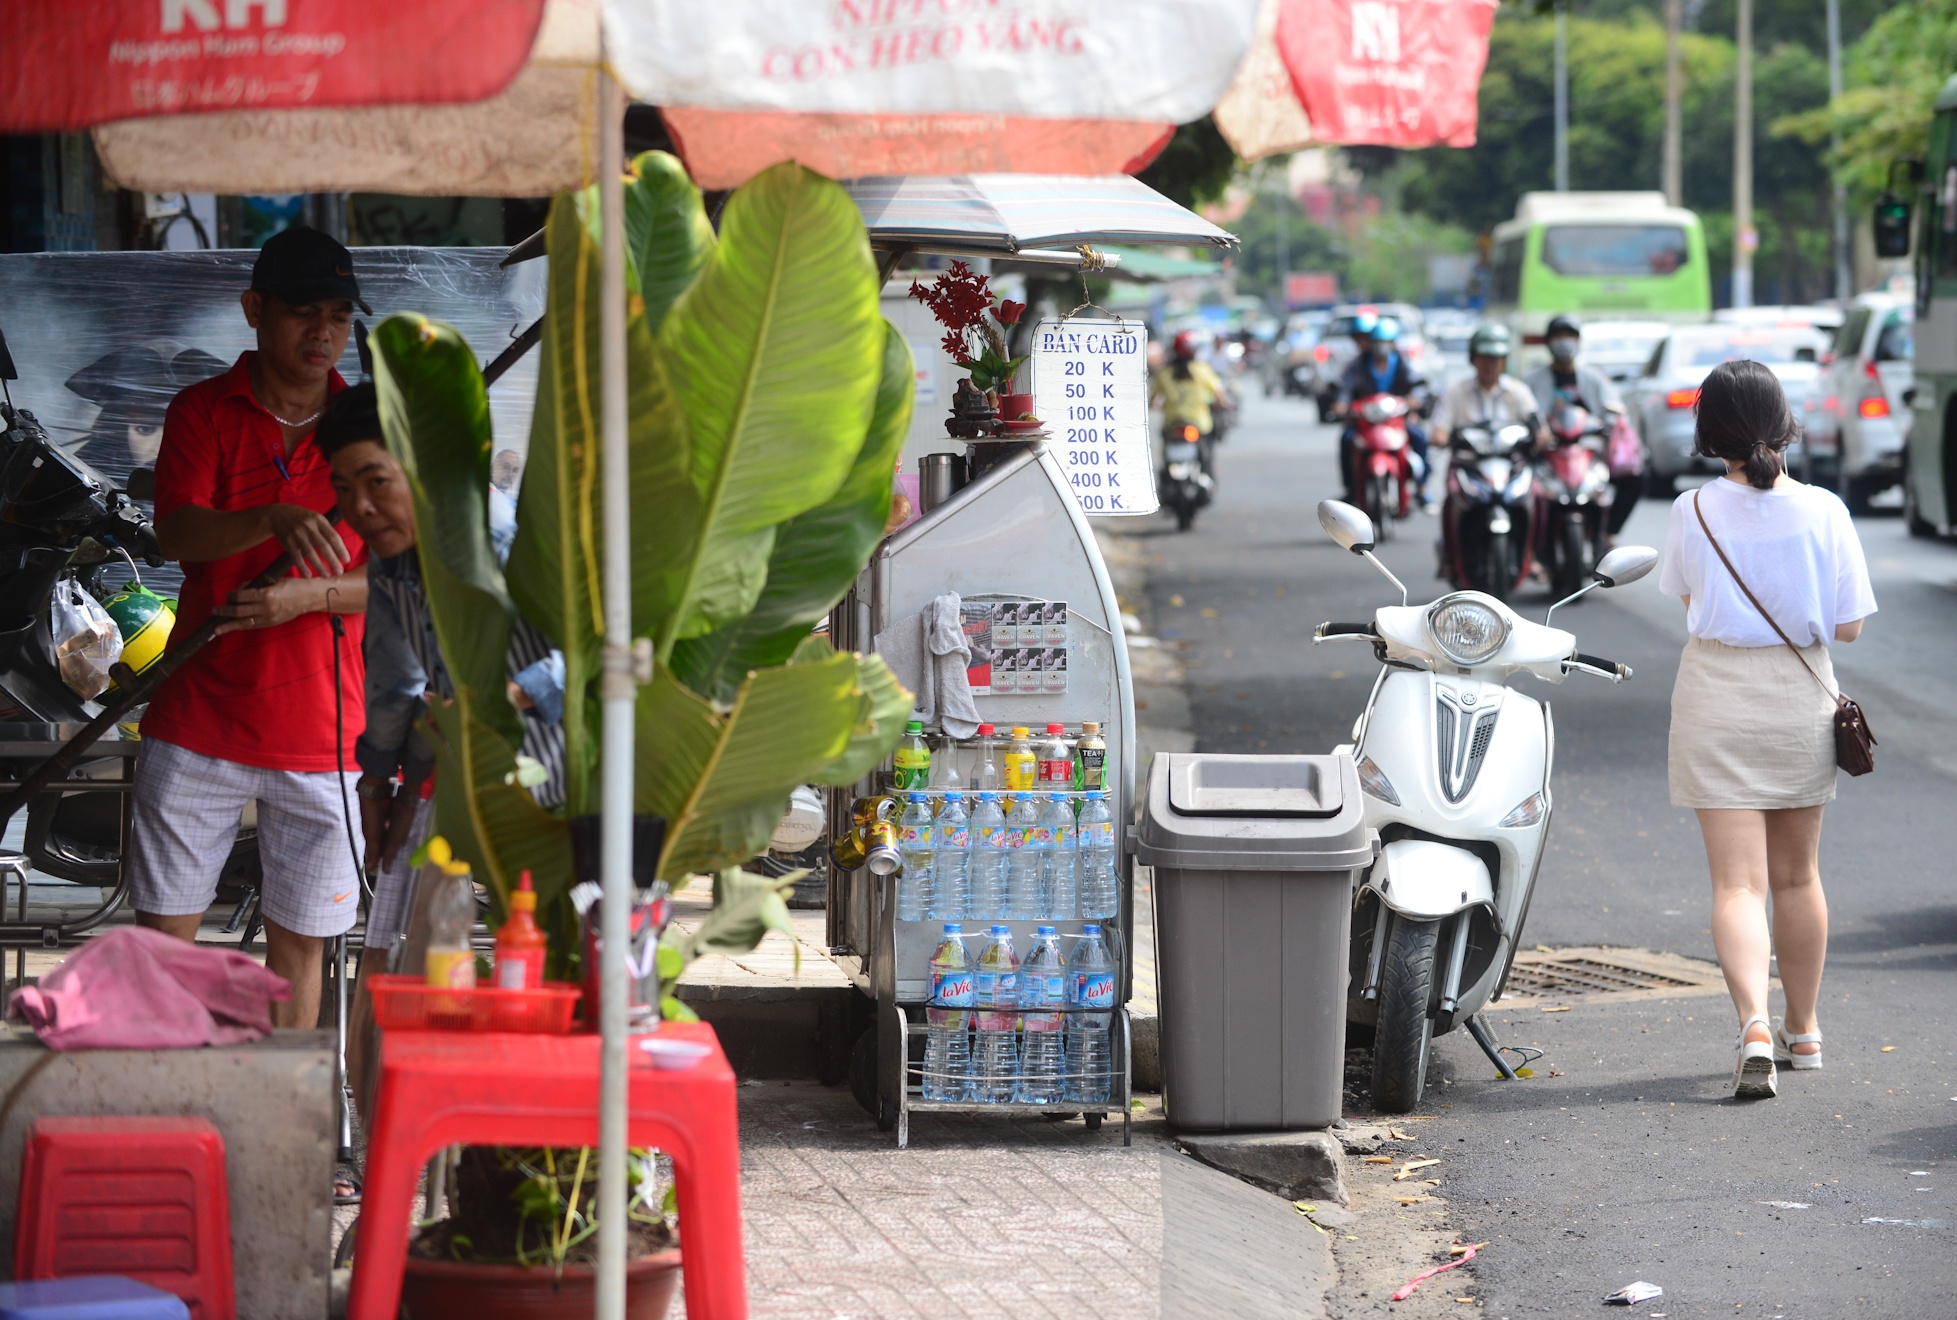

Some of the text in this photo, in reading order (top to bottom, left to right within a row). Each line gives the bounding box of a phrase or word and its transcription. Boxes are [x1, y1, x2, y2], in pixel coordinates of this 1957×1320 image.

[1042, 327, 1137, 355] BÁN CARD
[1065, 361, 1115, 376] 20 K
[1065, 383, 1115, 398] 50 K
[1069, 406, 1116, 421] 100 K
[1067, 428, 1117, 443] 200 K
[1069, 450, 1119, 465] 300 K
[1071, 472, 1121, 487] 400 K
[1110, 494, 1124, 509] K
